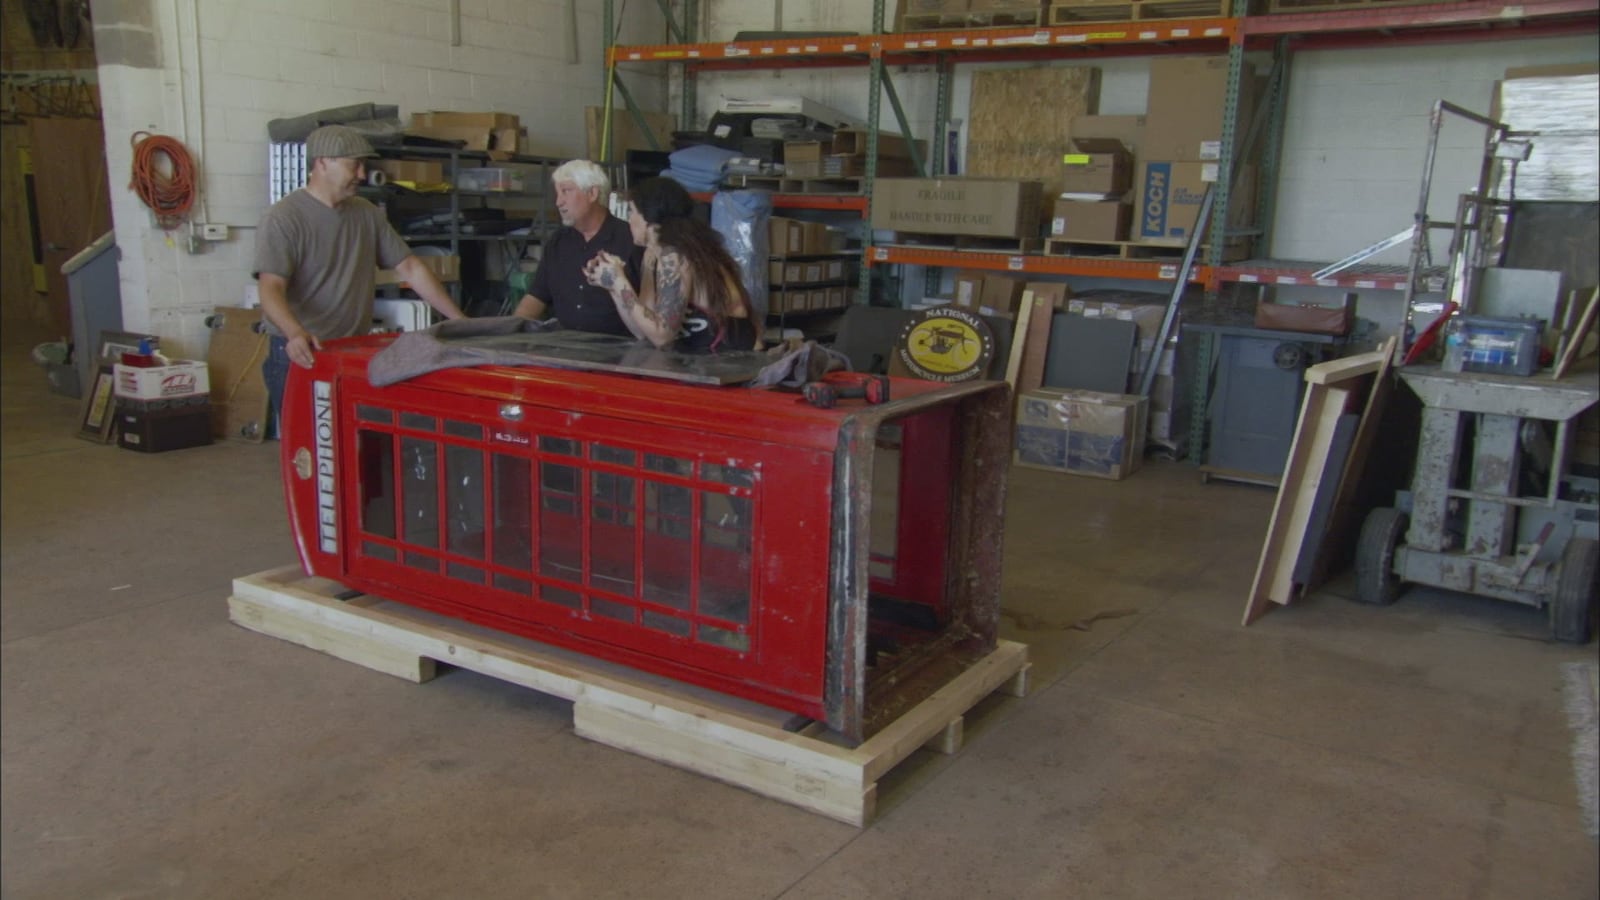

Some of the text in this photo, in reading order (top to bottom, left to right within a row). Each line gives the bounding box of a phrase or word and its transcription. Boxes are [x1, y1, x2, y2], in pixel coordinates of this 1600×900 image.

[917, 189, 967, 201] FRAGILE
[1146, 172, 1165, 232] KOCH
[889, 210, 993, 226] HANDLE WITH CARE
[925, 307, 980, 328] NATIONAL
[900, 348, 943, 381] MOTORCYCLE
[943, 366, 981, 382] MUSEUM
[315, 384, 336, 547] TELEPHONE
